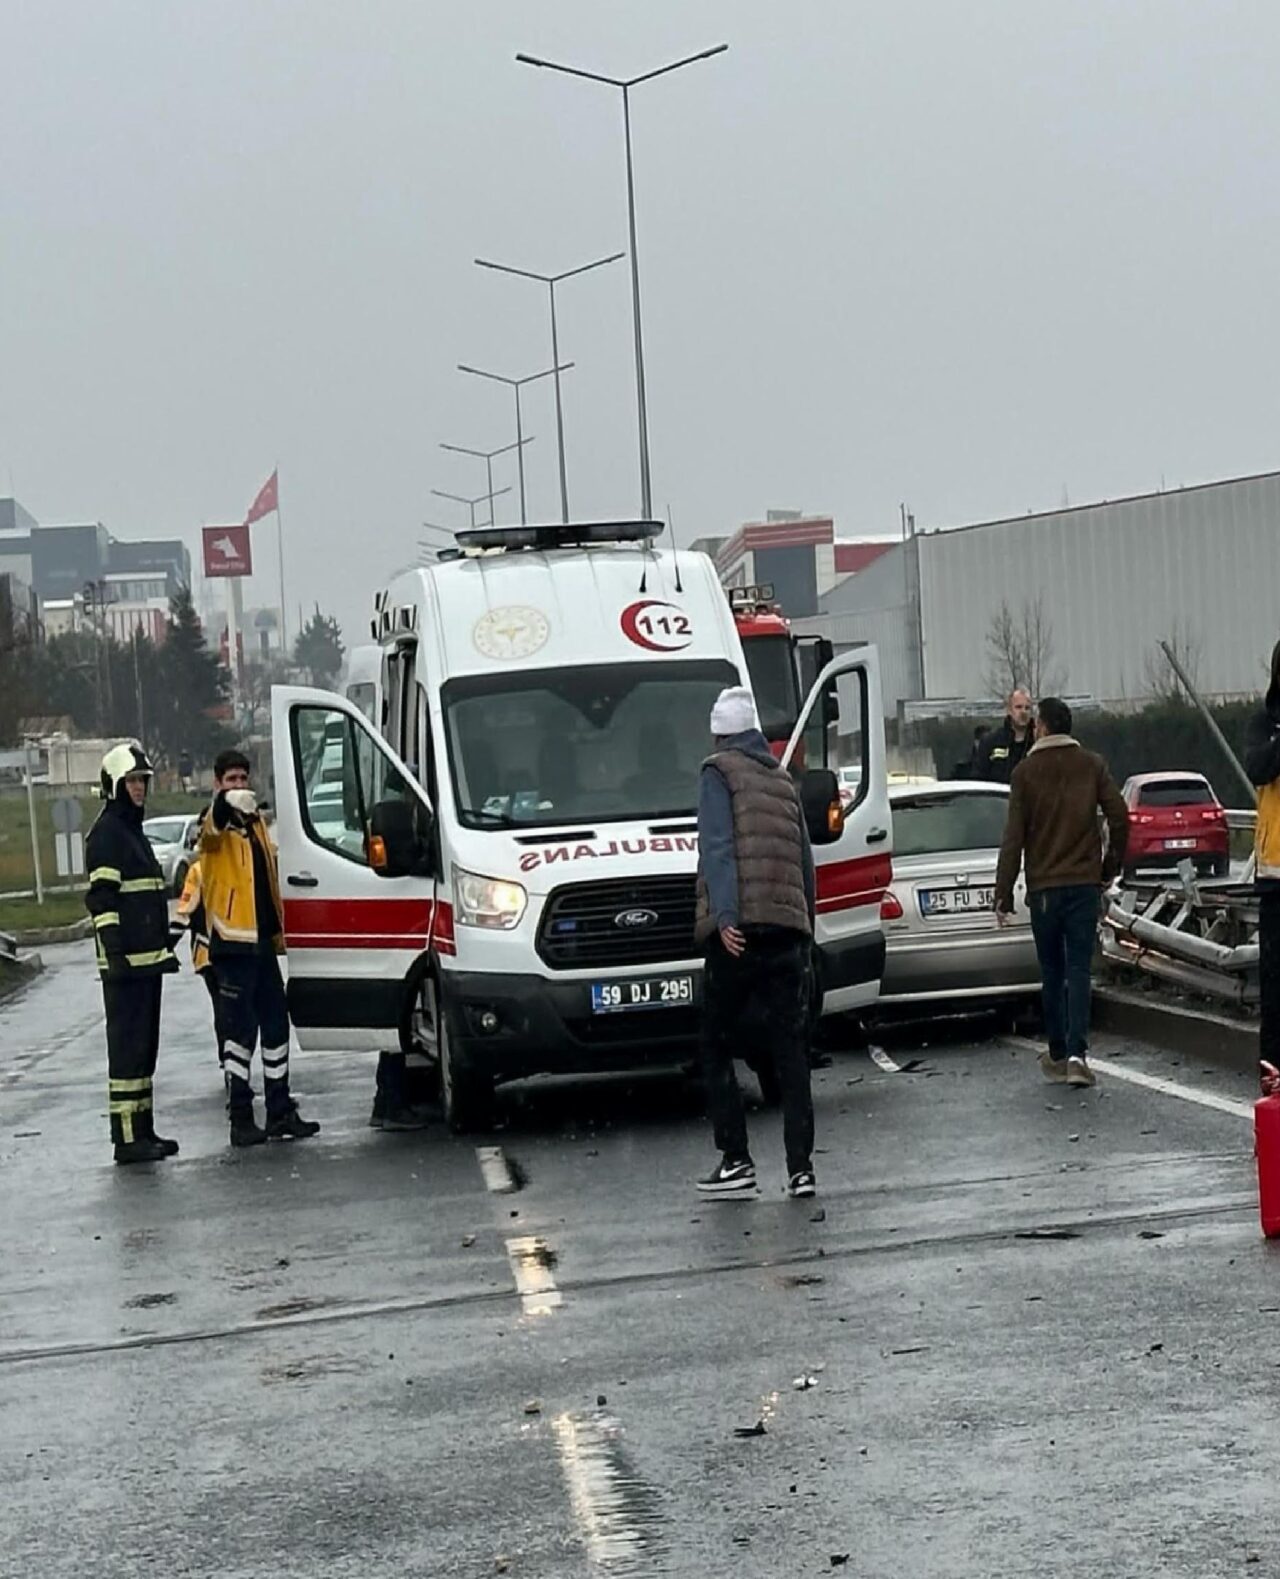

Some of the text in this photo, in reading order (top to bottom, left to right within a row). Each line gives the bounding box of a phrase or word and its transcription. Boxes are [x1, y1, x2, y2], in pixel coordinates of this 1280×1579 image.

[640, 616, 692, 635] 112
[931, 890, 994, 908] 25 FU 36
[602, 980, 688, 1005] 59 DJ 295
